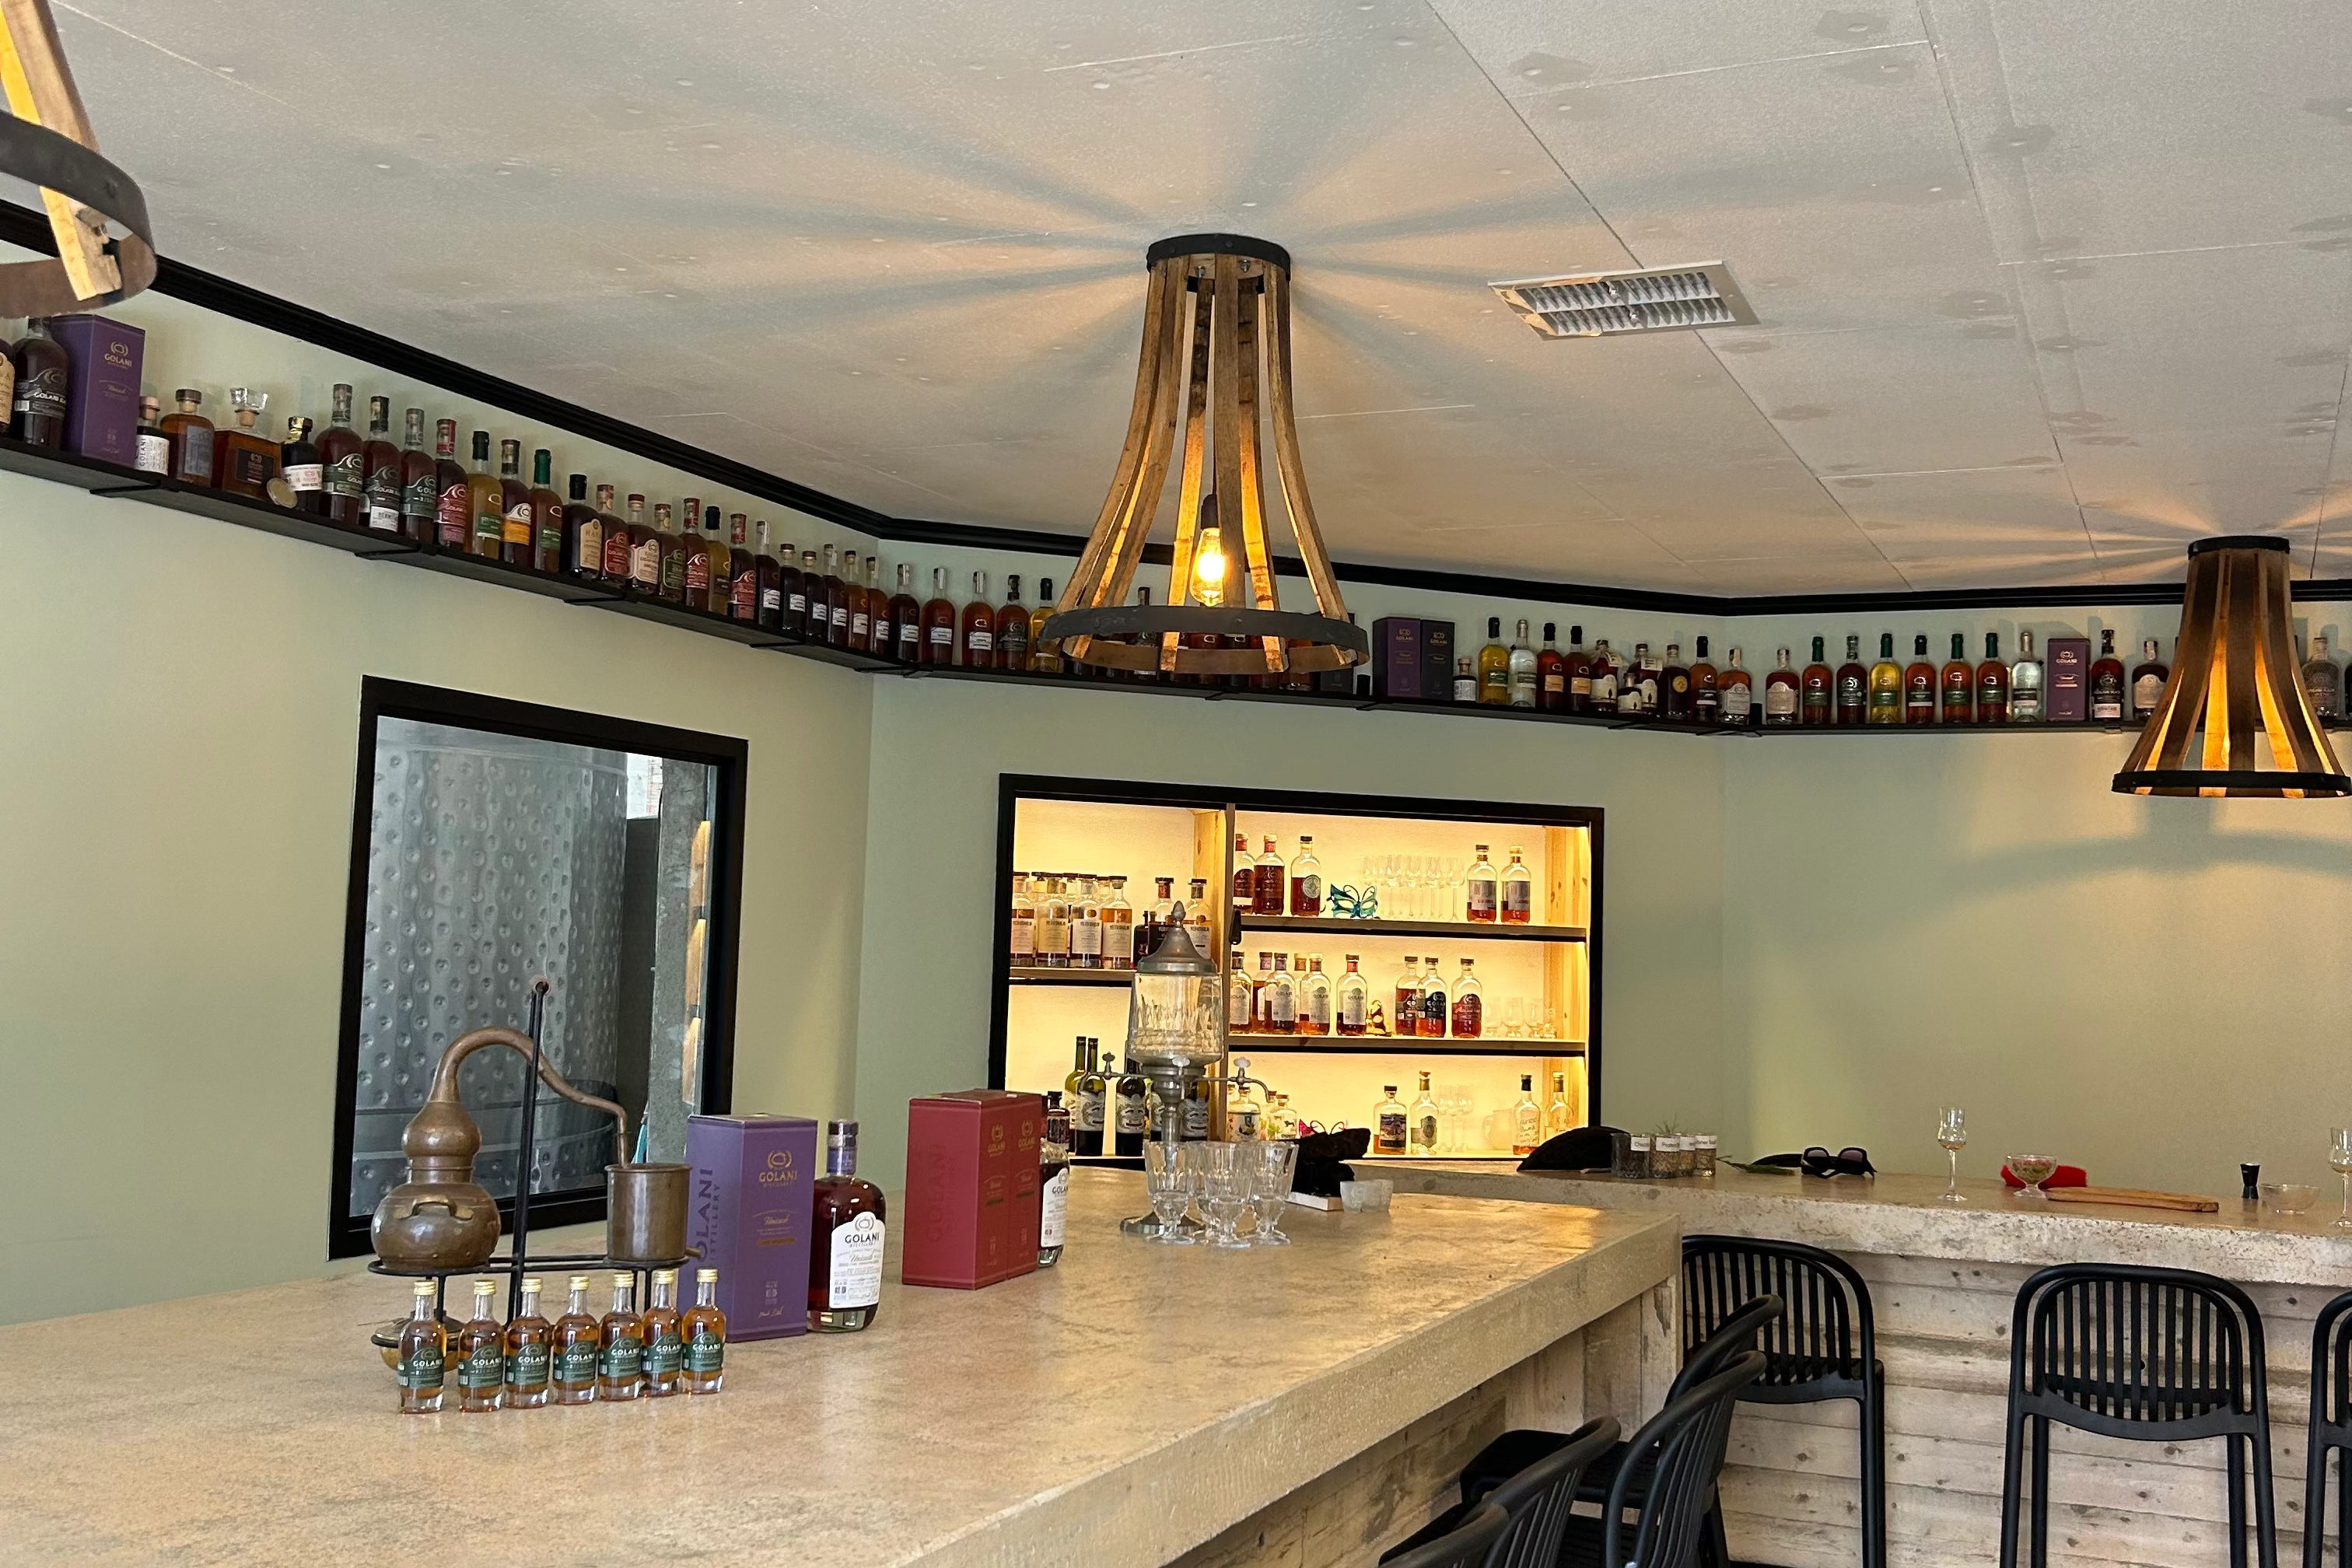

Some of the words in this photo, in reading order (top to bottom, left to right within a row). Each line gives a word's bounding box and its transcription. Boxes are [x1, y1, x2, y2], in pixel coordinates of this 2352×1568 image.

[105, 353, 132, 367] GOLANI
[758, 1170, 798, 1183] GOLANI
[696, 1169, 713, 1262] OLANI
[709, 1184, 720, 1260] ISTILLERY
[845, 1232, 880, 1244] GOLANI
